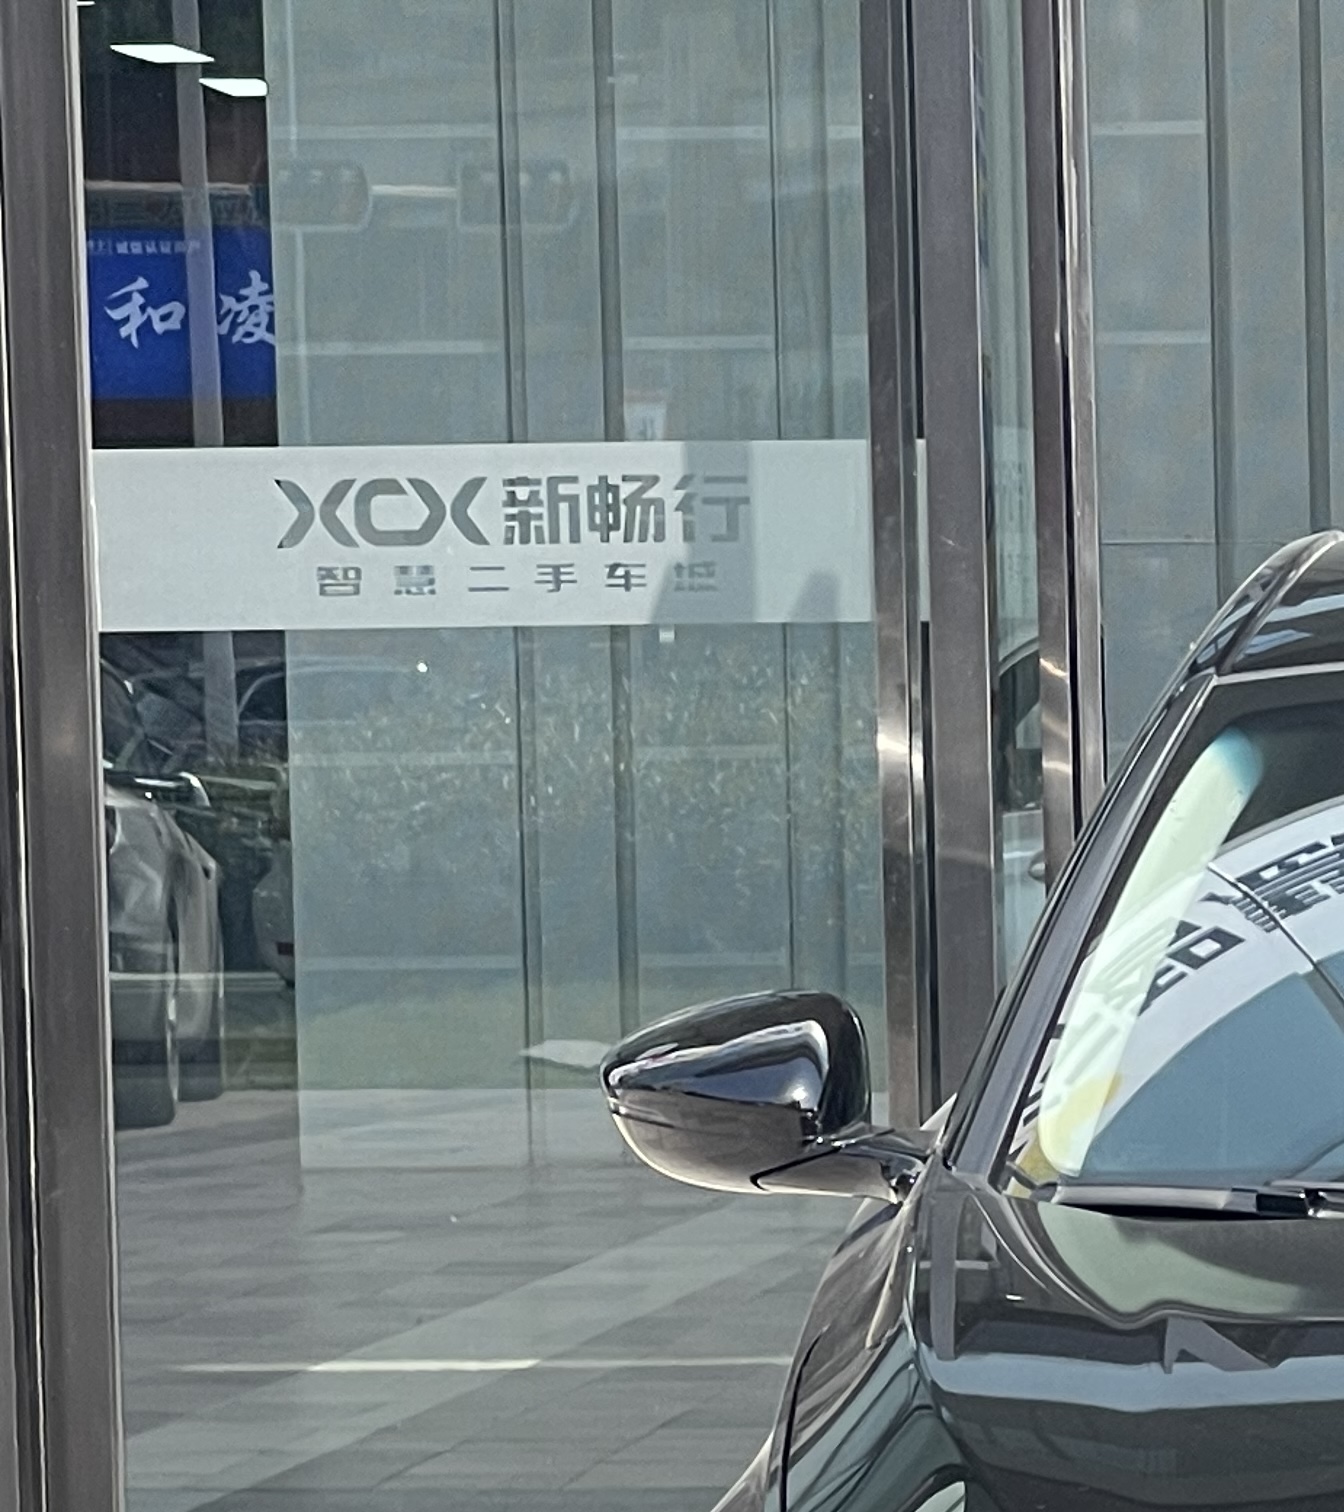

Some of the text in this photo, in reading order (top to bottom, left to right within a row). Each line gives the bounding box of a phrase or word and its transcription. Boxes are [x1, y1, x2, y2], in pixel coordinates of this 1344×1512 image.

[502, 474, 750, 545] 新畅行
[316, 561, 718, 596] 智慧二手车城
